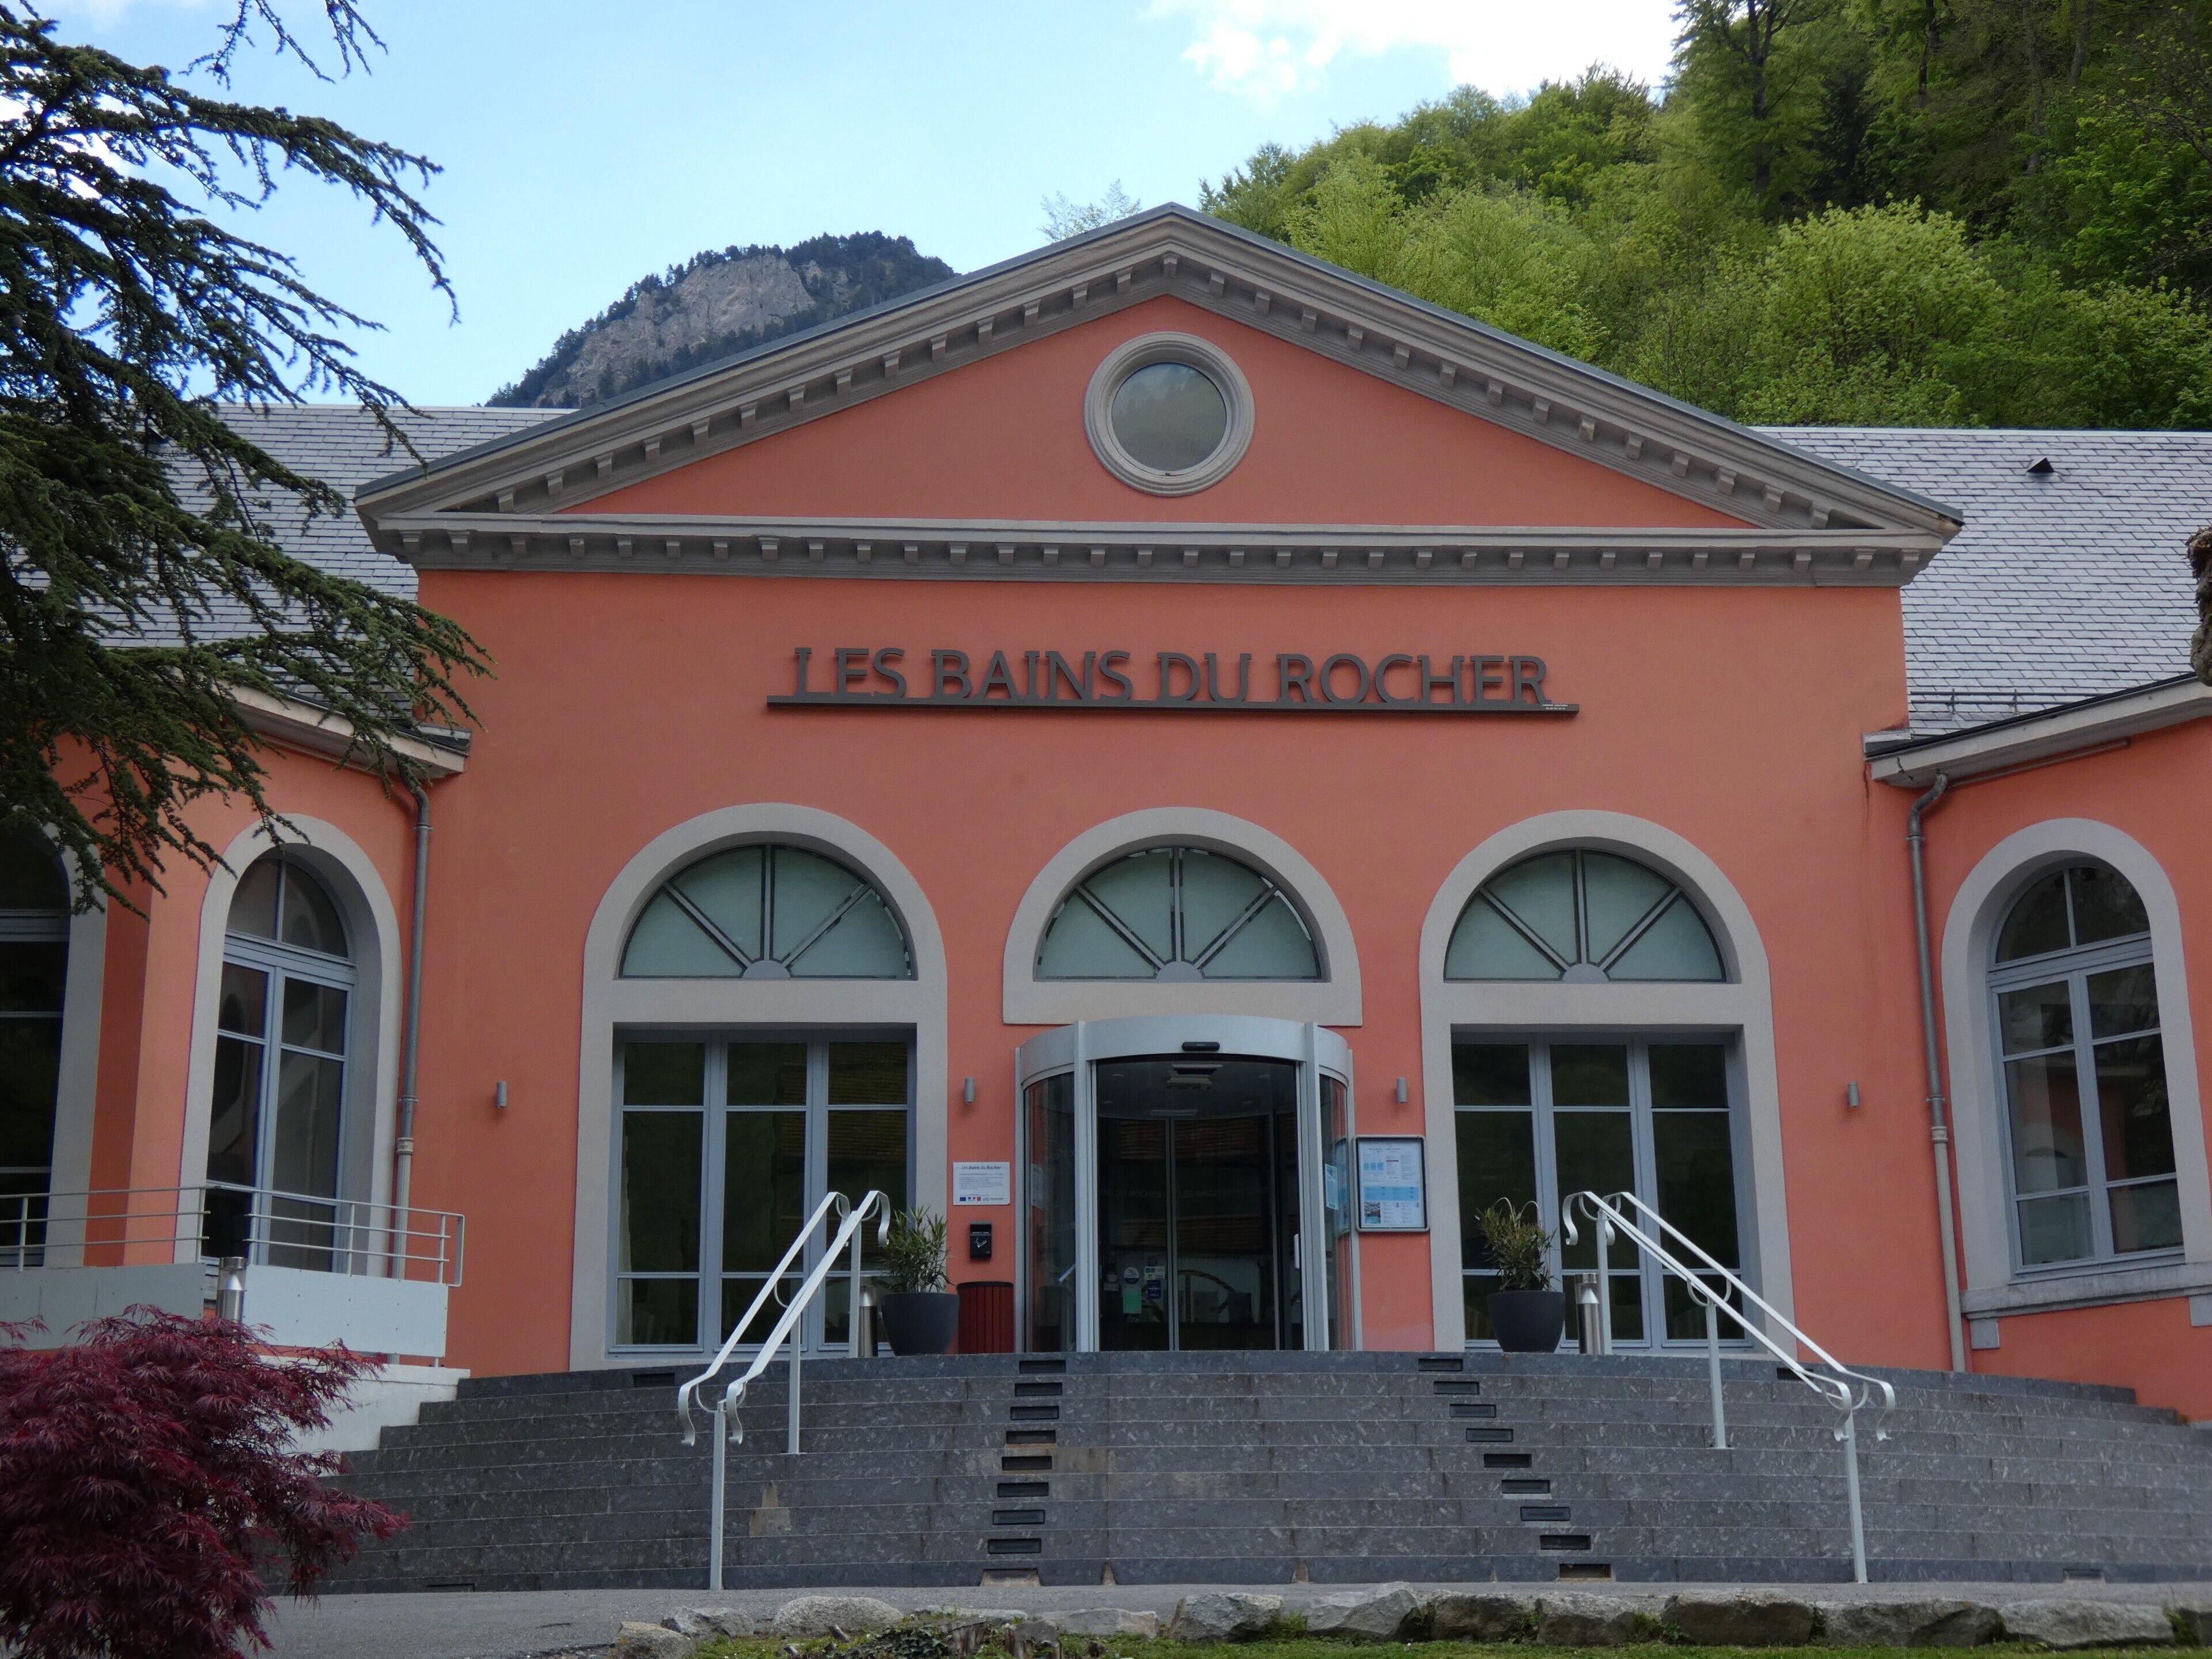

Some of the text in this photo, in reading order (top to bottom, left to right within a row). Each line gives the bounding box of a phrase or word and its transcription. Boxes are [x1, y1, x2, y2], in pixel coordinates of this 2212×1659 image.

[794, 646, 1553, 704] LES BAINS DU ROCHER
